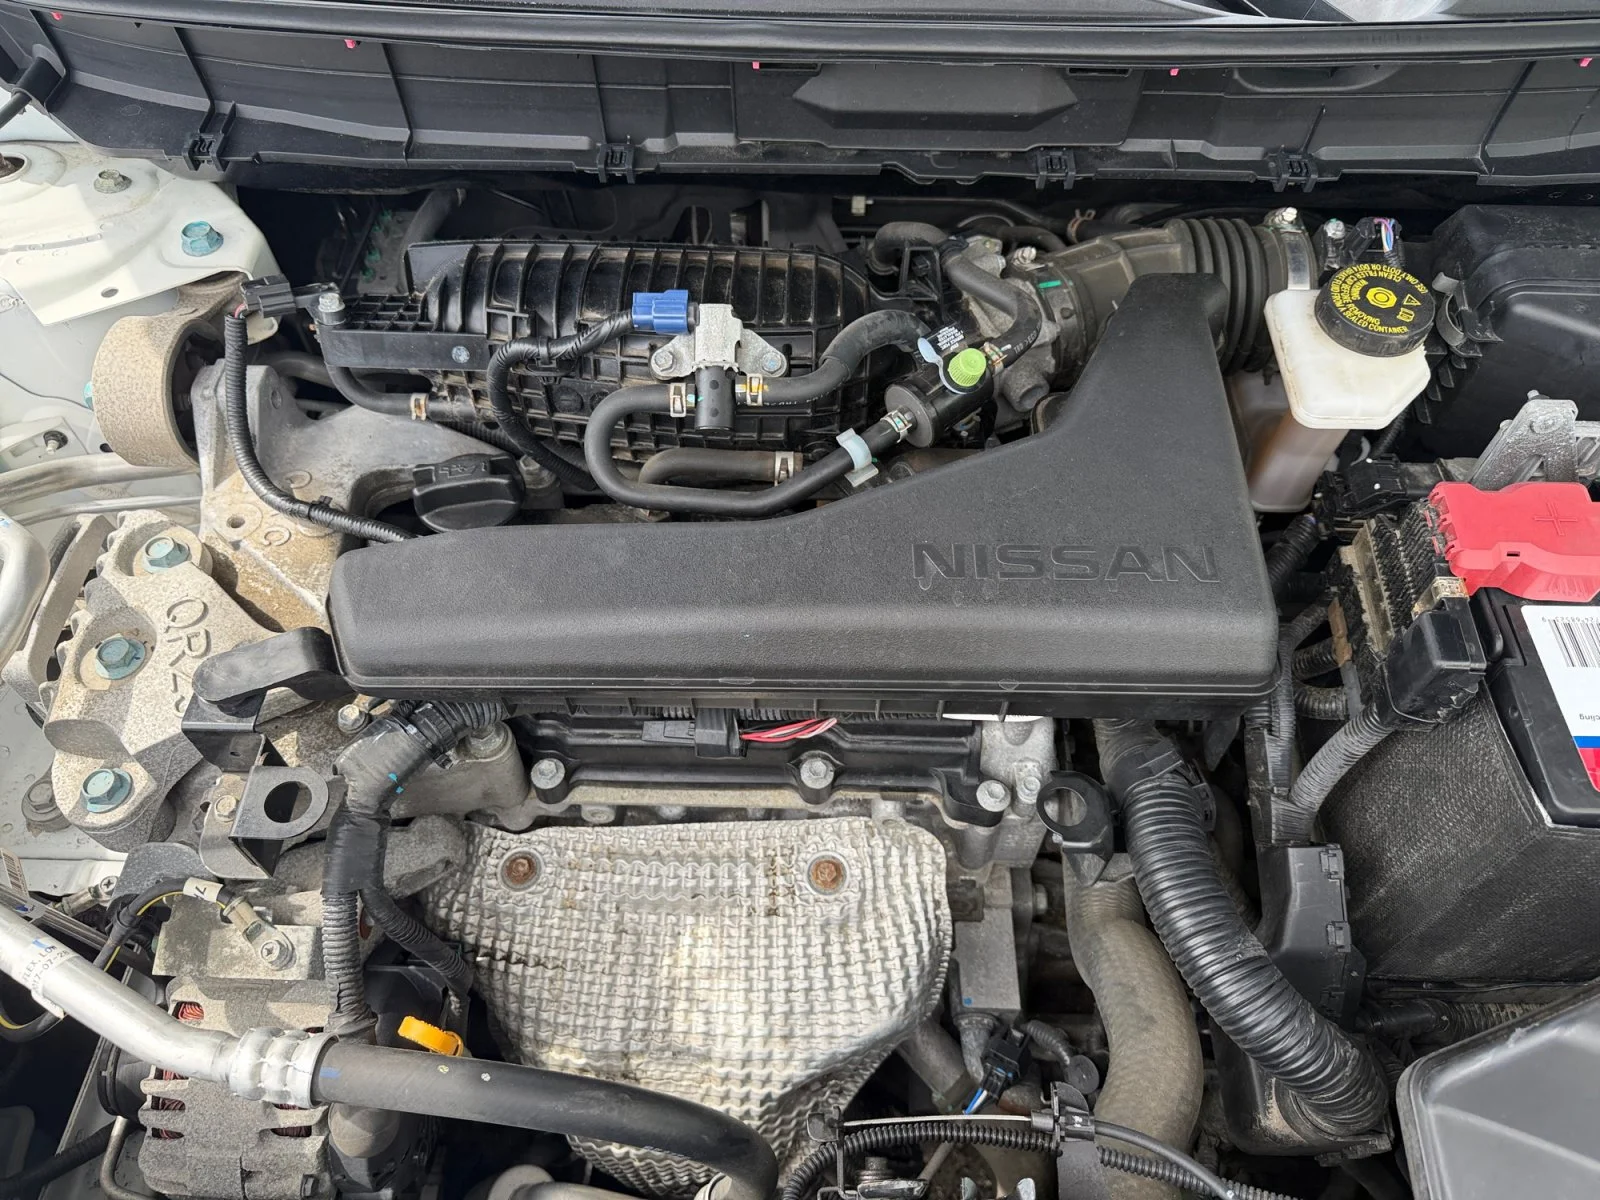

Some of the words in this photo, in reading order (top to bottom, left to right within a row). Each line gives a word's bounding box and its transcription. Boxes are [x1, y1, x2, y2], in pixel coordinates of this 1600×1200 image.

[1355, 270, 1377, 279] FILLER
[1378, 271, 1402, 282] CLEAN
[1402, 272, 1419, 285] ONLY
[1415, 284, 1428, 294] USE
[1343, 309, 1368, 327] SEALED
[1346, 303, 1380, 325] REMOVING
[1368, 323, 1409, 334] CONTAINER
[911, 543, 1221, 583] NISSAN
